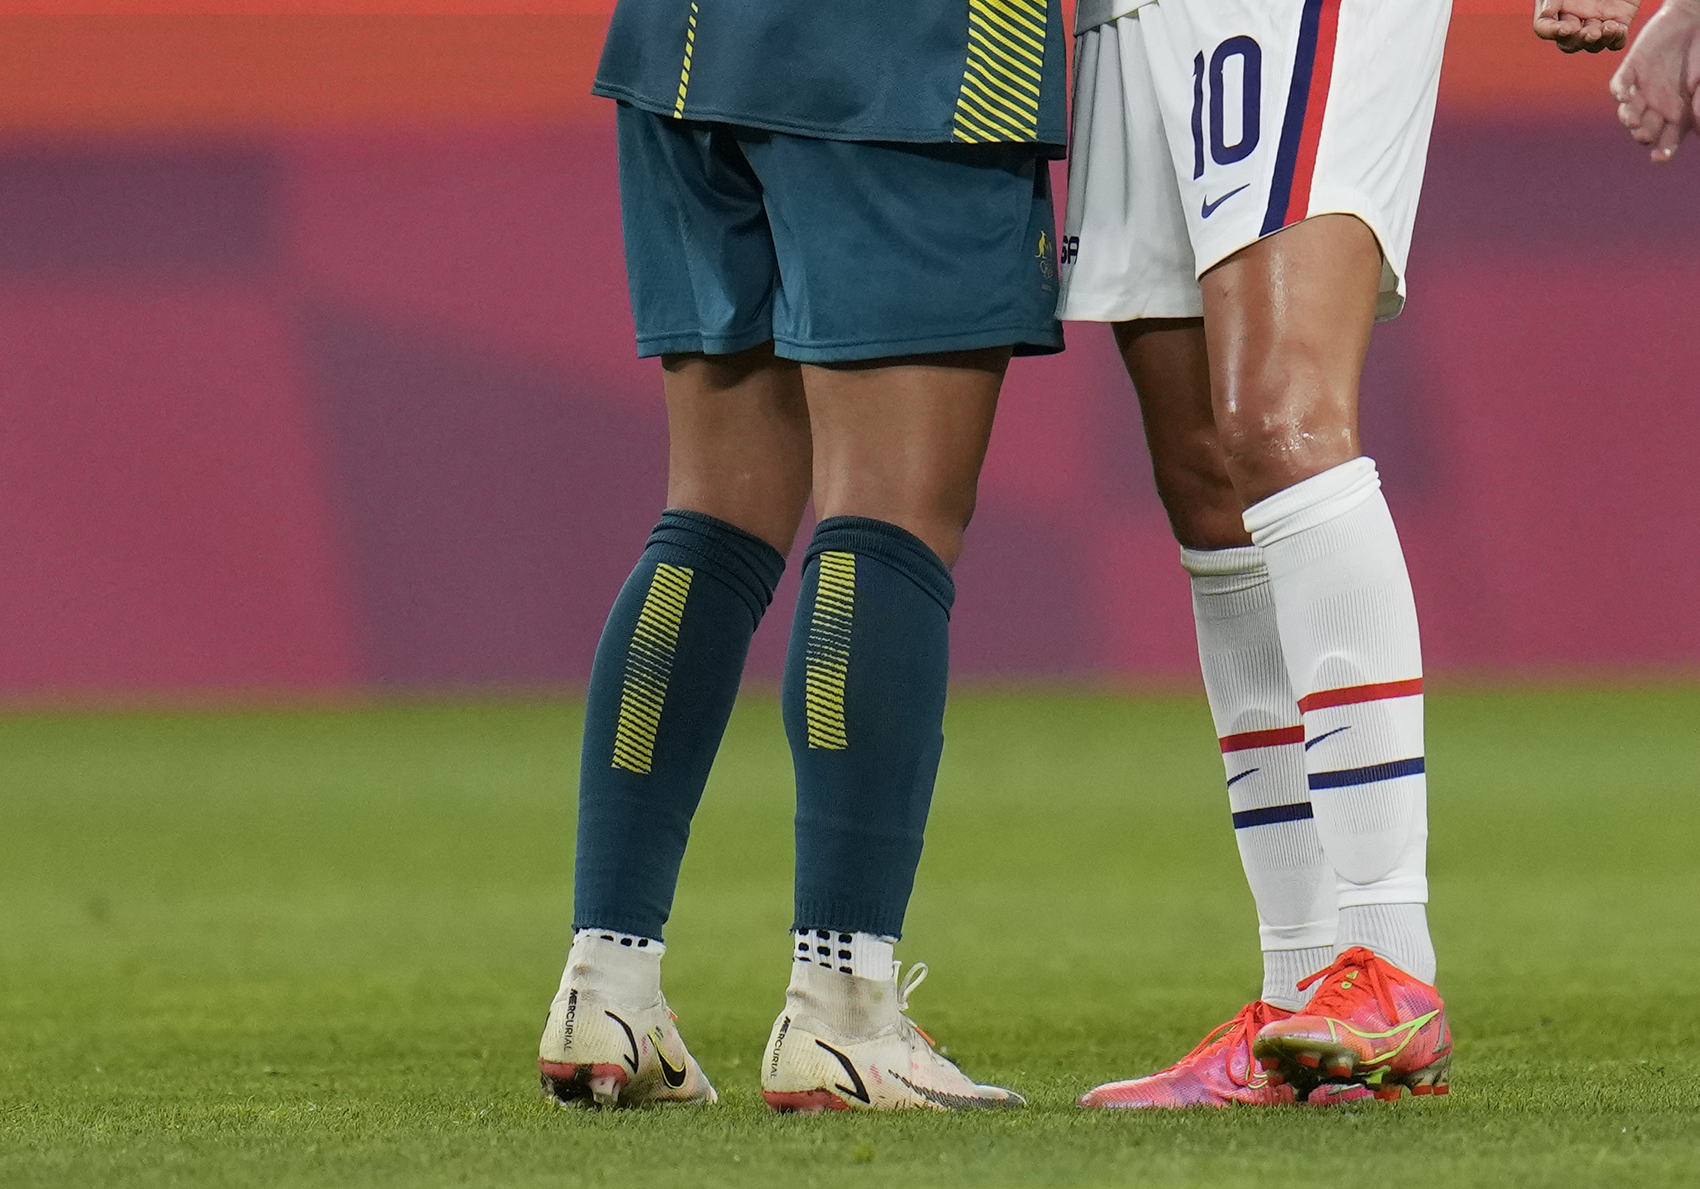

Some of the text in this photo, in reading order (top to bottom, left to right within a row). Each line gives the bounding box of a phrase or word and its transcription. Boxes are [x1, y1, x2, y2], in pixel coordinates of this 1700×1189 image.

[1191, 34, 1262, 180] 10
[1061, 235, 1080, 265] SA
[563, 988, 579, 1053] MERCURIAL
[770, 1016, 791, 1079] MERCURIAL
